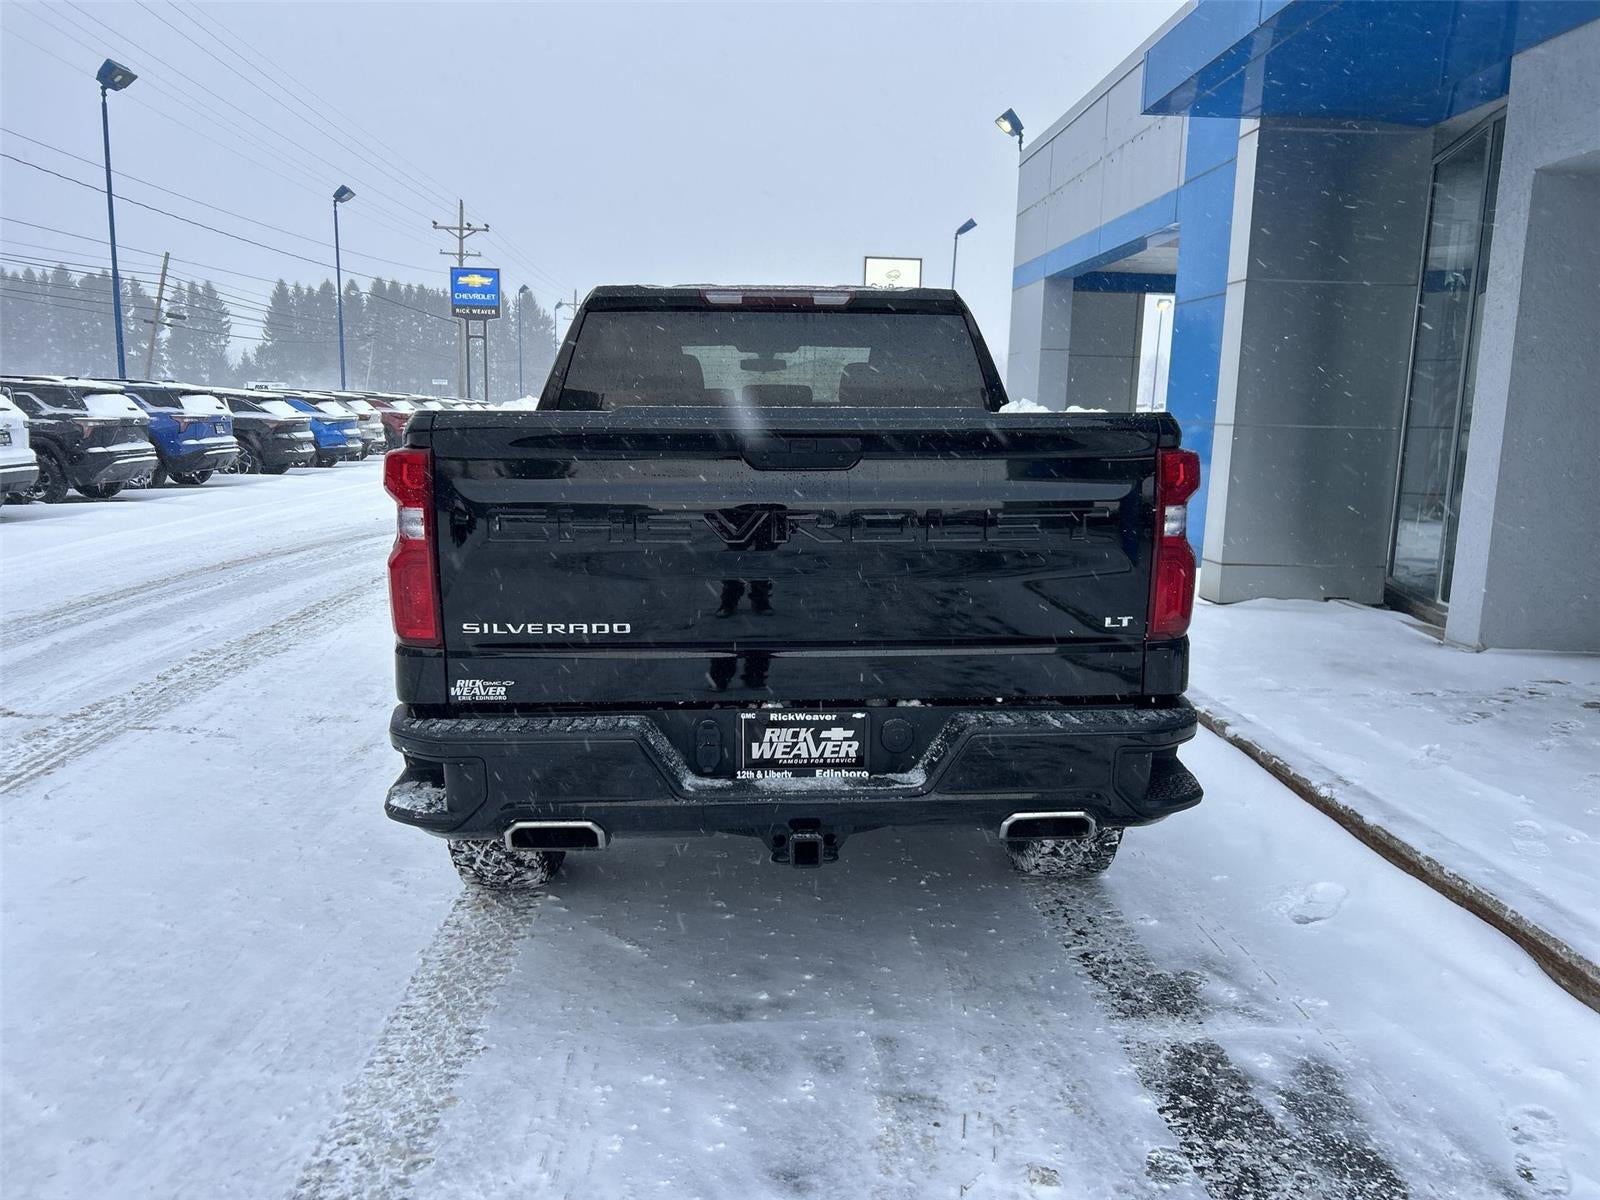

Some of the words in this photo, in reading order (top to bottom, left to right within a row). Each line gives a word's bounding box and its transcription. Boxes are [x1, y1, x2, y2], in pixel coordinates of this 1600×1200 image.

[454, 292, 496, 300] CHEVROLET
[486, 507, 1110, 543] CHEVROLET
[1104, 616, 1134, 628] LT
[462, 623, 632, 634] SILVERADO
[456, 679, 484, 688] RICK
[450, 686, 506, 696] WEAVER
[769, 712, 837, 721] RickWeaver
[763, 727, 815, 742] RICK
[751, 740, 860, 759] WEAVER
[736, 770, 755, 779] 12th
[756, 770, 763, 779] &
[764, 769, 793, 778] Liberty
[815, 769, 870, 778] Edinboro
